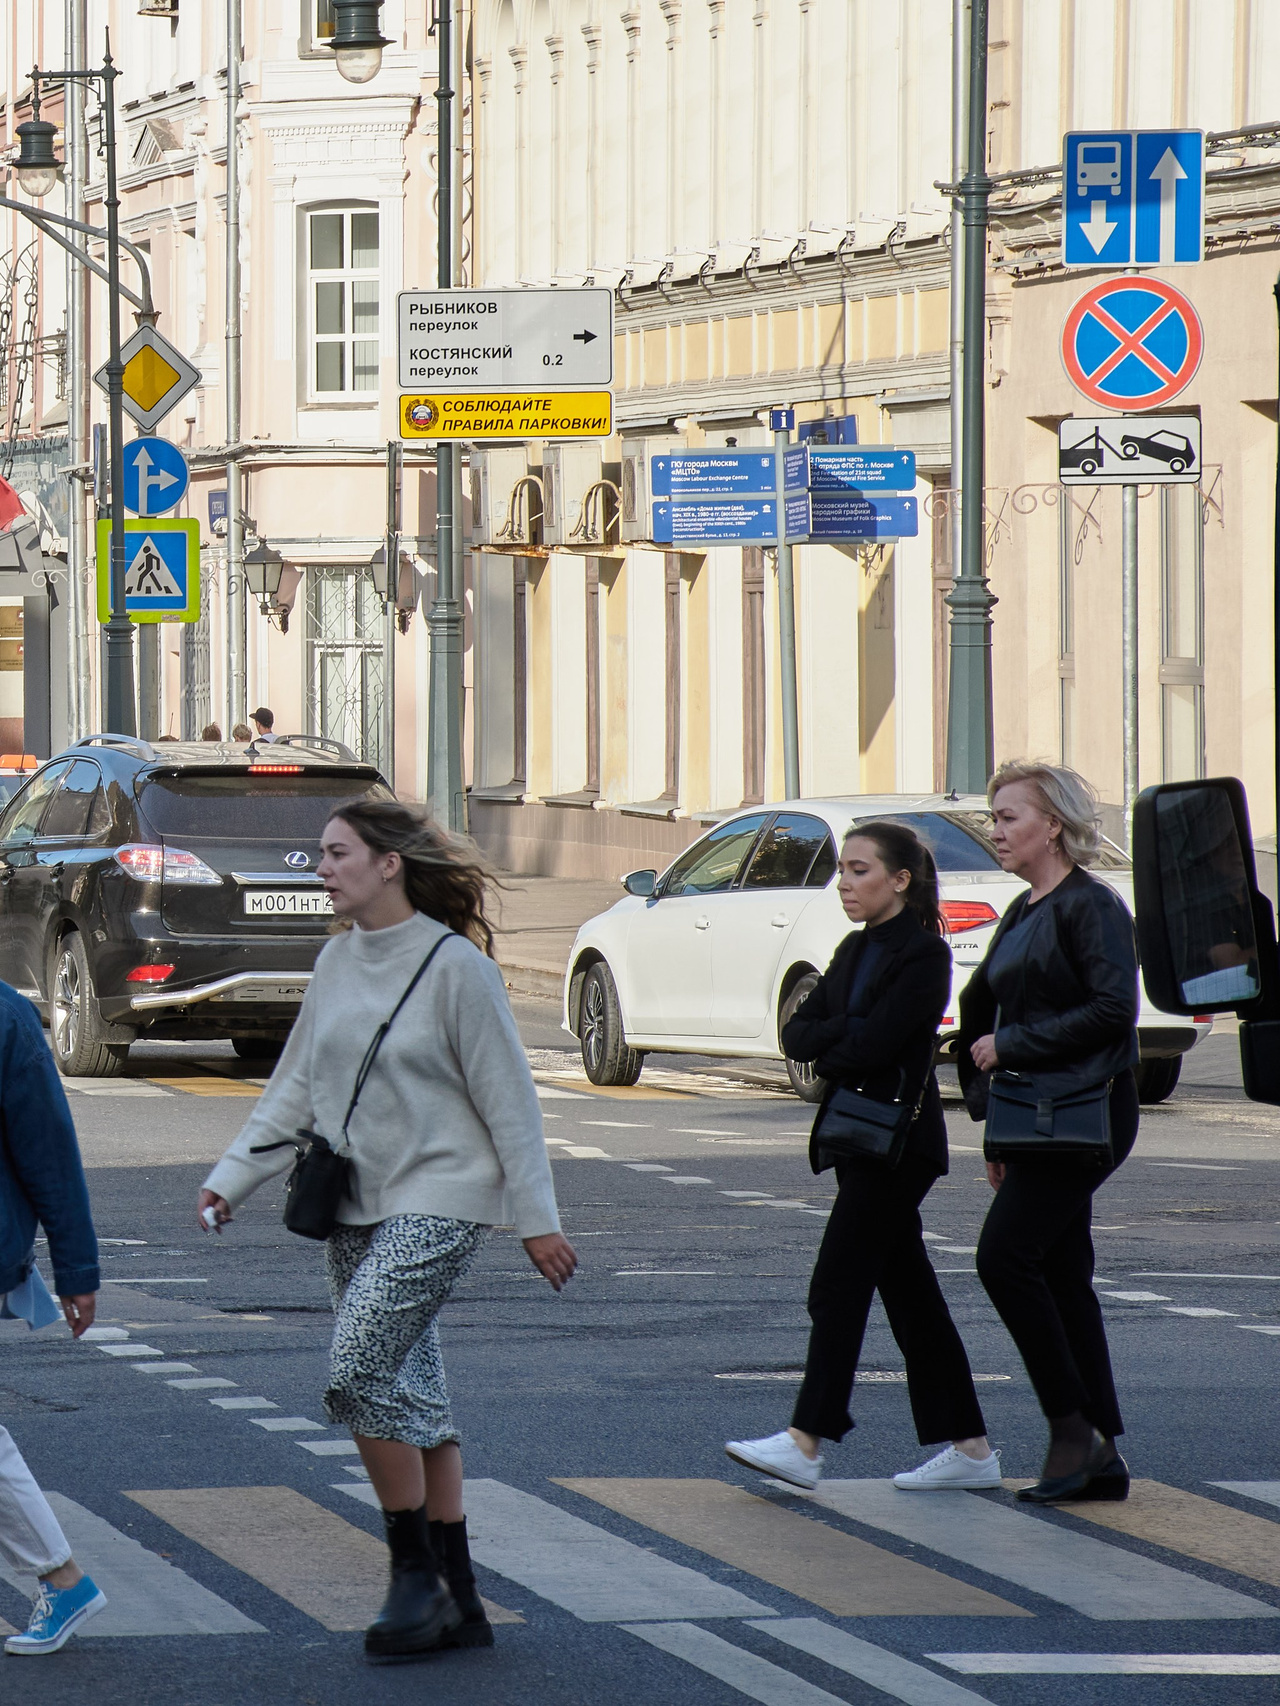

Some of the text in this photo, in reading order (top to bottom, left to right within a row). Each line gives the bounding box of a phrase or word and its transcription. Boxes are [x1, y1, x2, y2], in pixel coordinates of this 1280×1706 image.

[409, 302, 498, 315] РЫБНИКОВ
[409, 321, 478, 333] переулок
[410, 345, 513, 360] КОСТЯНСКИЙ
[543, 354, 563, 367] 0.2
[409, 366, 478, 378] переулок
[442, 397, 552, 414] СОБЛЮДАЙТЕ
[442, 417, 606, 432] ПРАВИЛА ПАРКОВКИ!
[684, 460, 709, 469] города
[850, 502, 869, 510] музей
[252, 895, 320, 911] М001НТ
